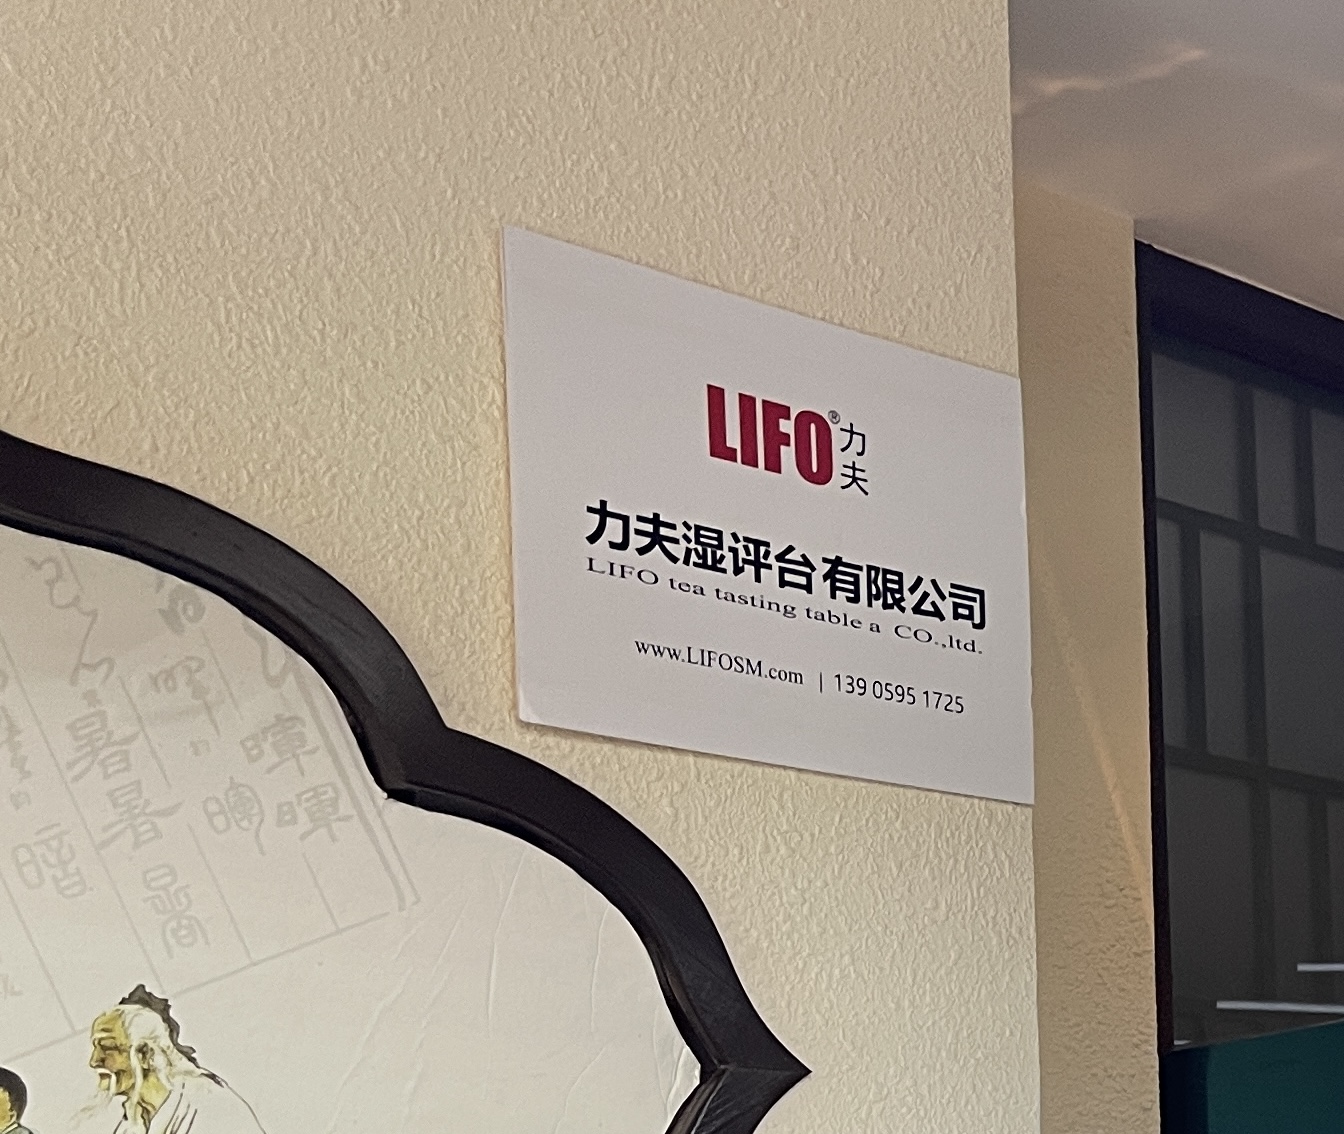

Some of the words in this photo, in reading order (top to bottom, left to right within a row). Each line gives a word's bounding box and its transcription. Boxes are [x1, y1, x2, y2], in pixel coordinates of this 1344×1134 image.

[706, 383, 834, 486] LIFO
[839, 422, 869, 496] 力夫
[585, 499, 986, 630] 力夫湿评台有限公司
[586, 557, 660, 586] LIFO
[668, 576, 706, 597] tea
[714, 586, 798, 619] tasting
[804, 605, 862, 631] table
[634, 637, 804, 686] www.LIFOSM.com
[834, 674, 867, 697] 139
[872, 682, 916, 706] 0595
[922, 690, 964, 715] 1725
